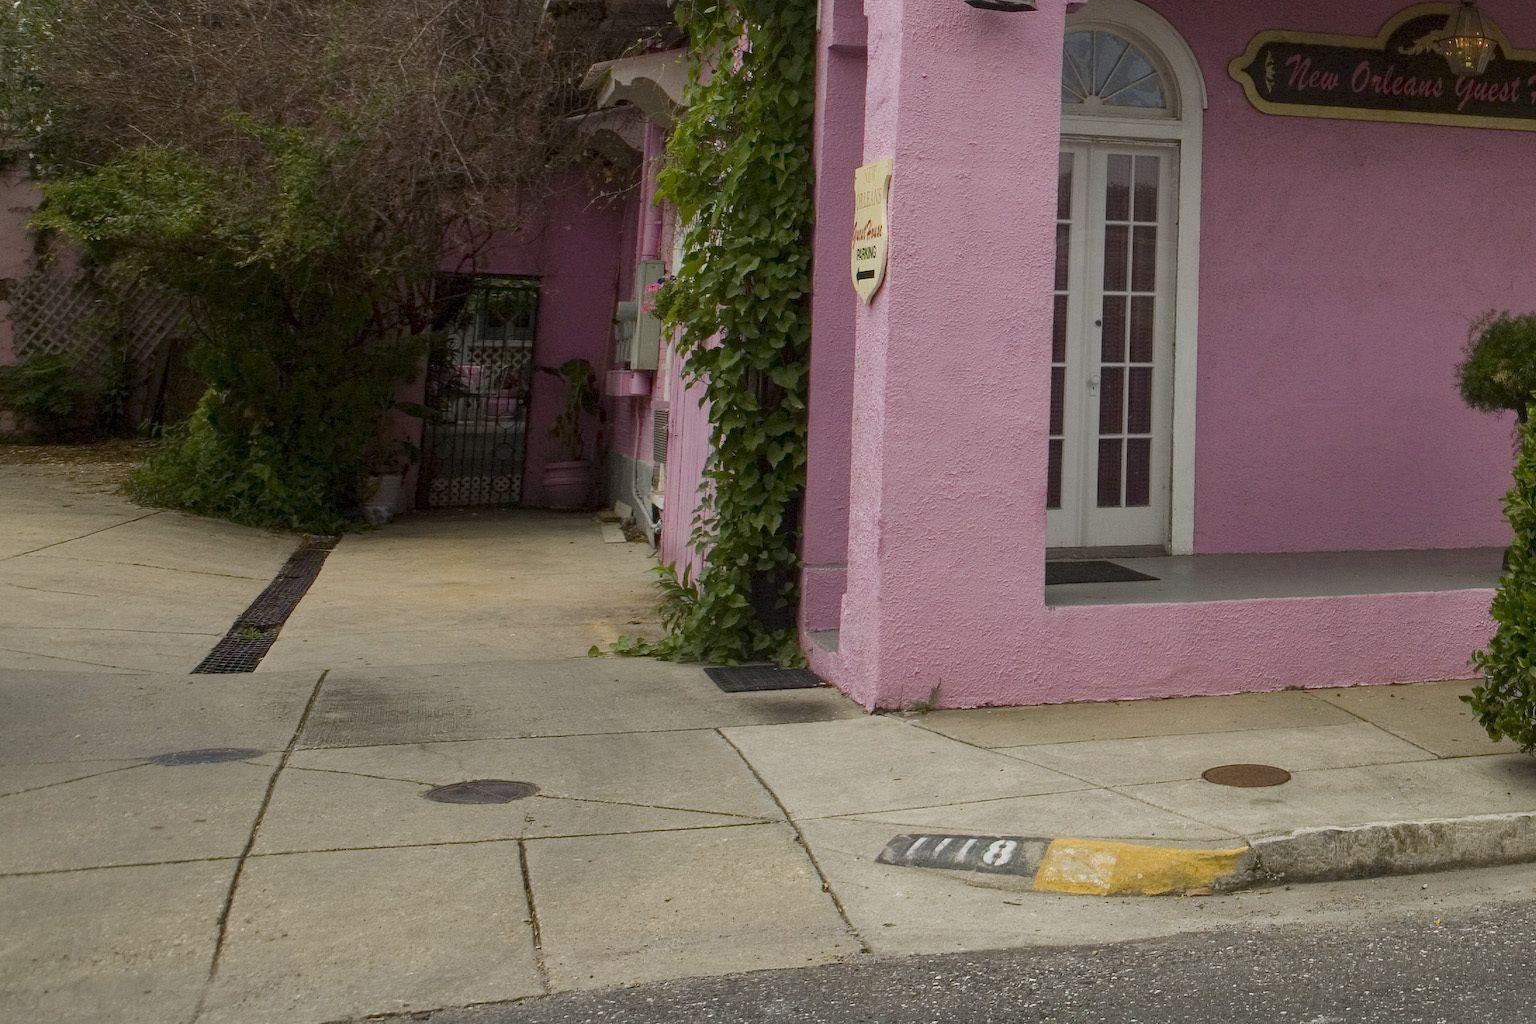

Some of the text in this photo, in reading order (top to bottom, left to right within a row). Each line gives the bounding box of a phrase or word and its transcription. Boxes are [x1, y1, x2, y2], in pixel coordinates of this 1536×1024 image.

[1285, 53, 1340, 92] New
[1351, 60, 1443, 97] Orleans
[1455, 75, 1520, 111] Guest
[856, 245, 877, 261] PARKING
[904, 837, 1018, 866] 1118
